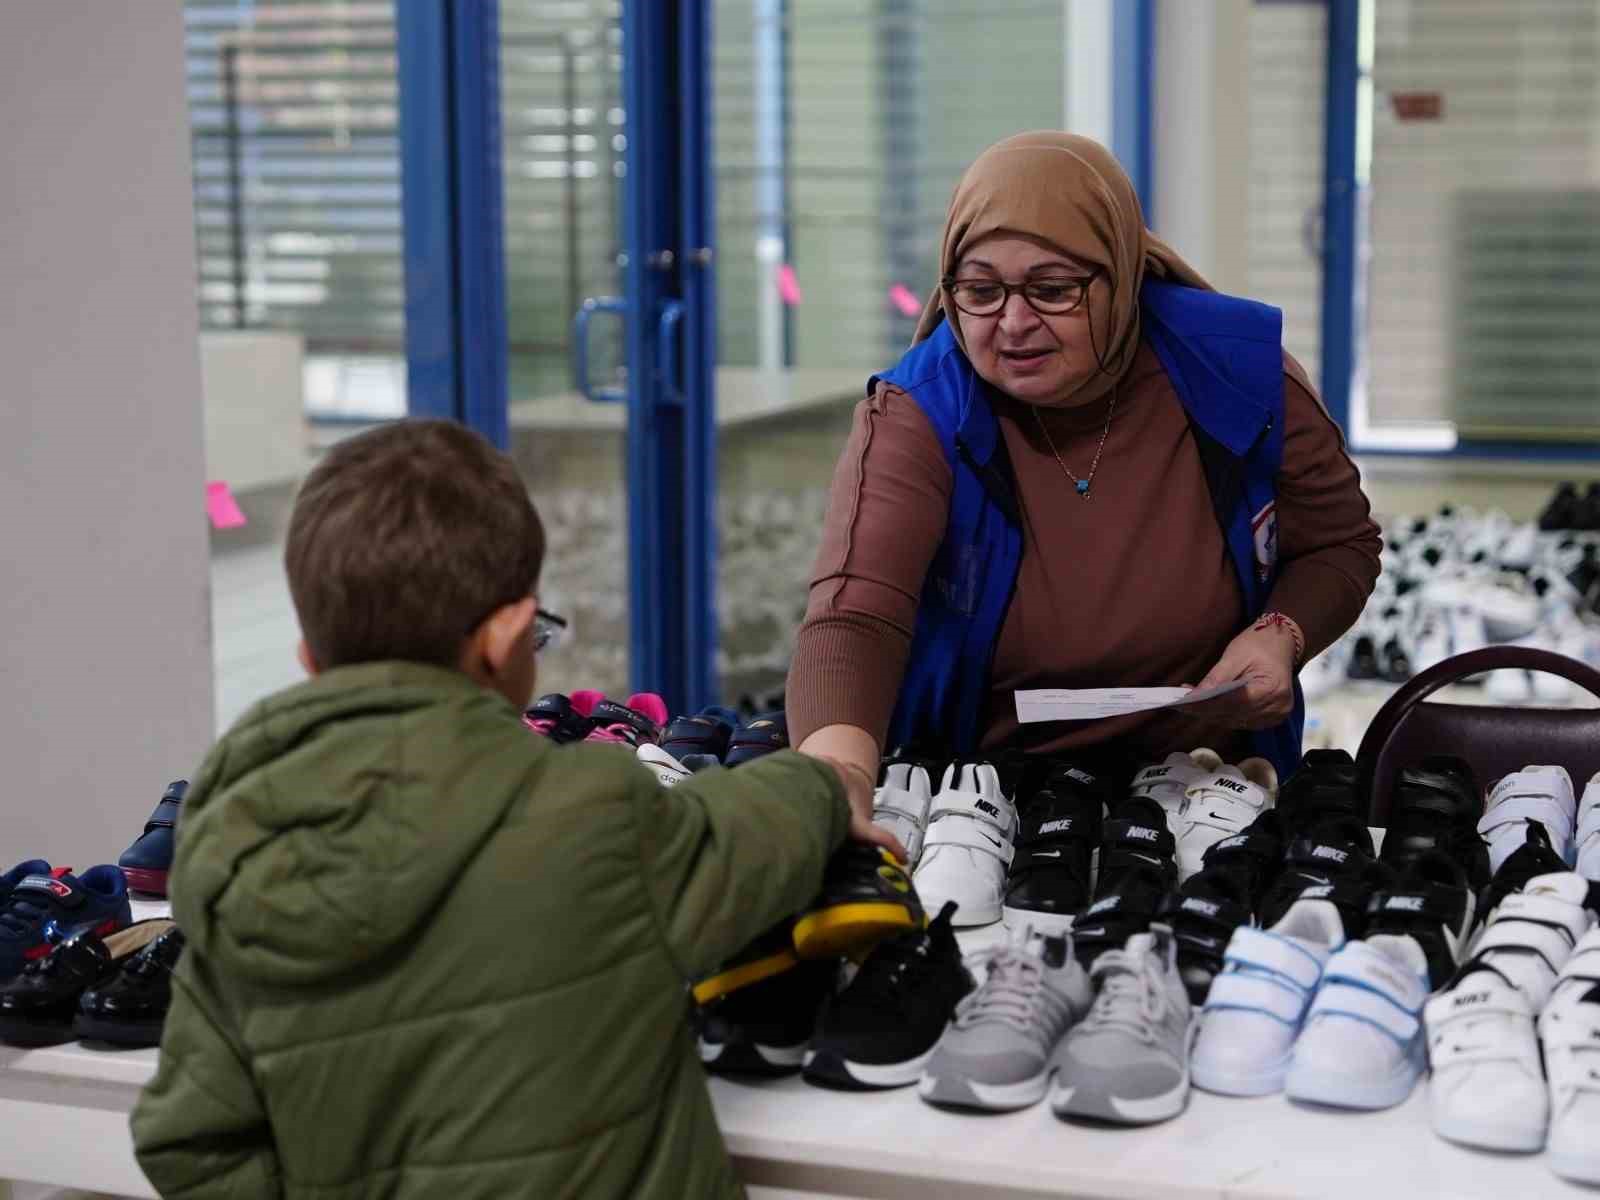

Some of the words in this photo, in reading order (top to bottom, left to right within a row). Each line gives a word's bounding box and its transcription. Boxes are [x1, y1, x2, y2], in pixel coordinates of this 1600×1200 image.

[1214, 778, 1249, 794] NIKE
[974, 798, 1000, 819] NIKE
[1039, 819, 1073, 834] NIKE
[1126, 825, 1160, 842] NIKE
[1312, 845, 1349, 863] NIKE
[1181, 897, 1220, 916] NIKE
[1385, 896, 1425, 911] NIKE
